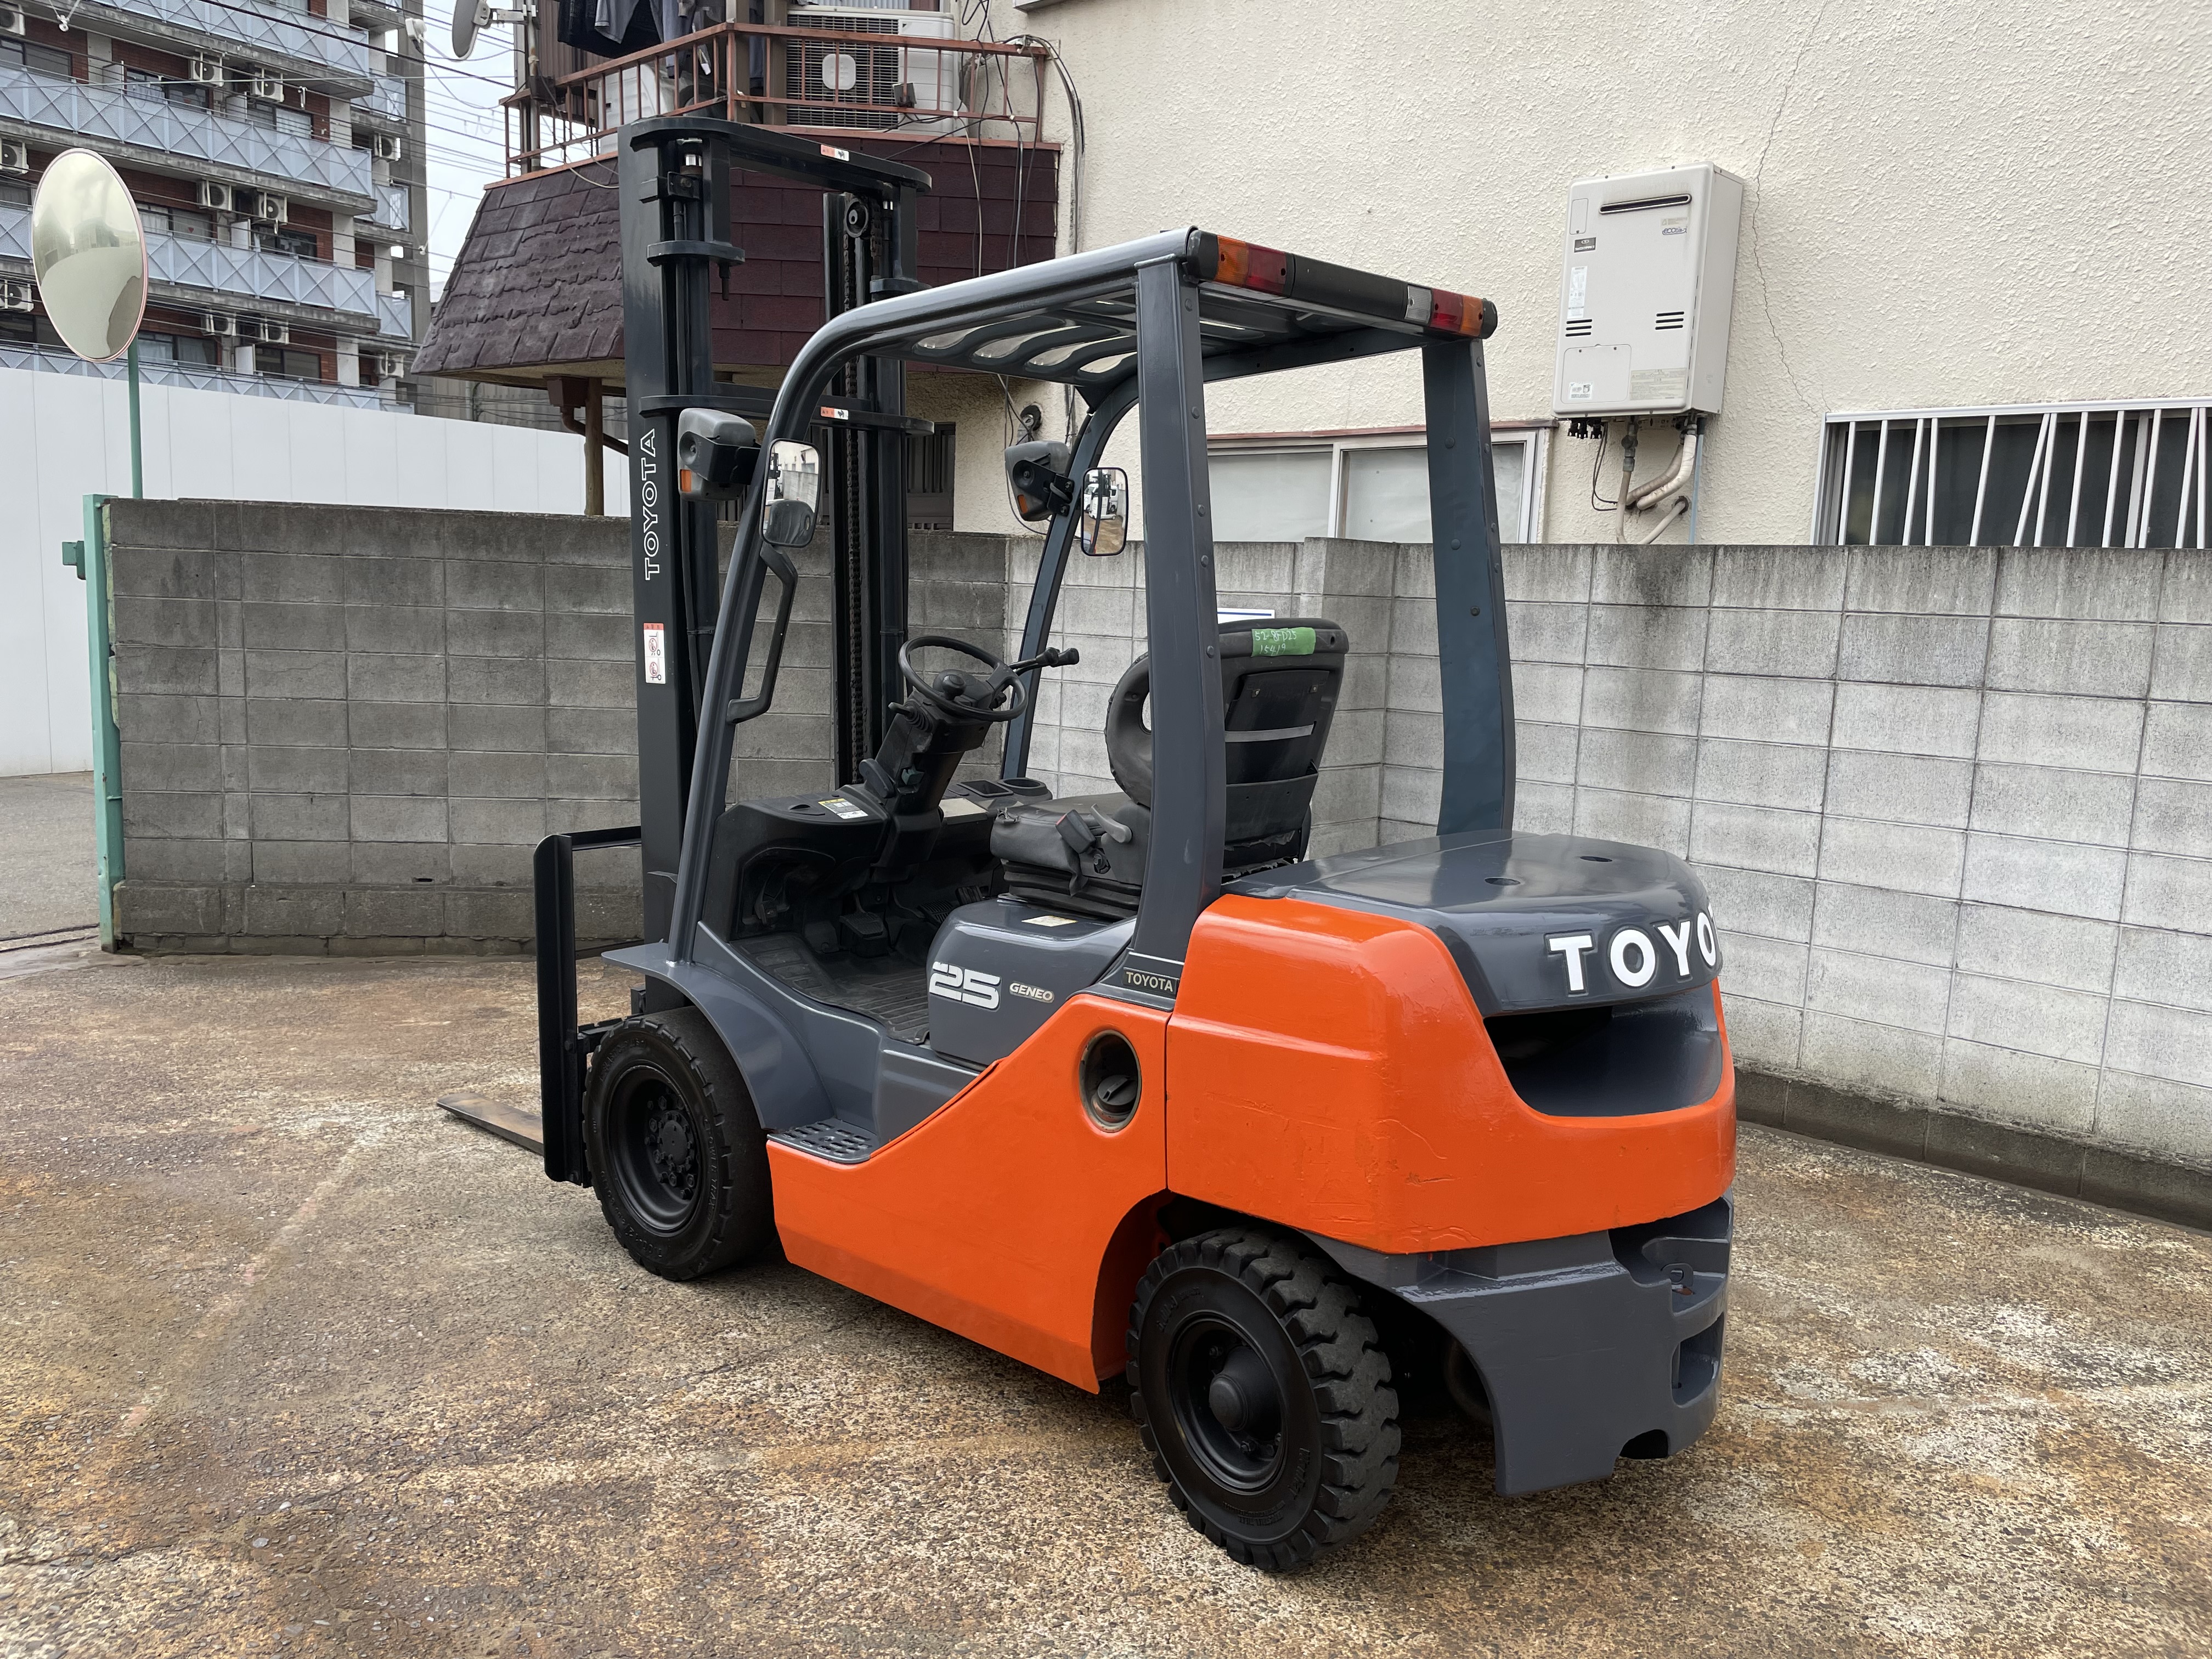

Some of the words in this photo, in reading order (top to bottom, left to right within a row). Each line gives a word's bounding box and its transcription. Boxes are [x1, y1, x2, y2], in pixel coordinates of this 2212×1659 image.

[640, 428, 660, 580] TOYOTA
[1549, 902, 1722, 991] TOYO
[929, 961, 1001, 1009] 25
[1009, 982, 1053, 1001] GENEO
[1126, 971, 1173, 992] TOYOTA
